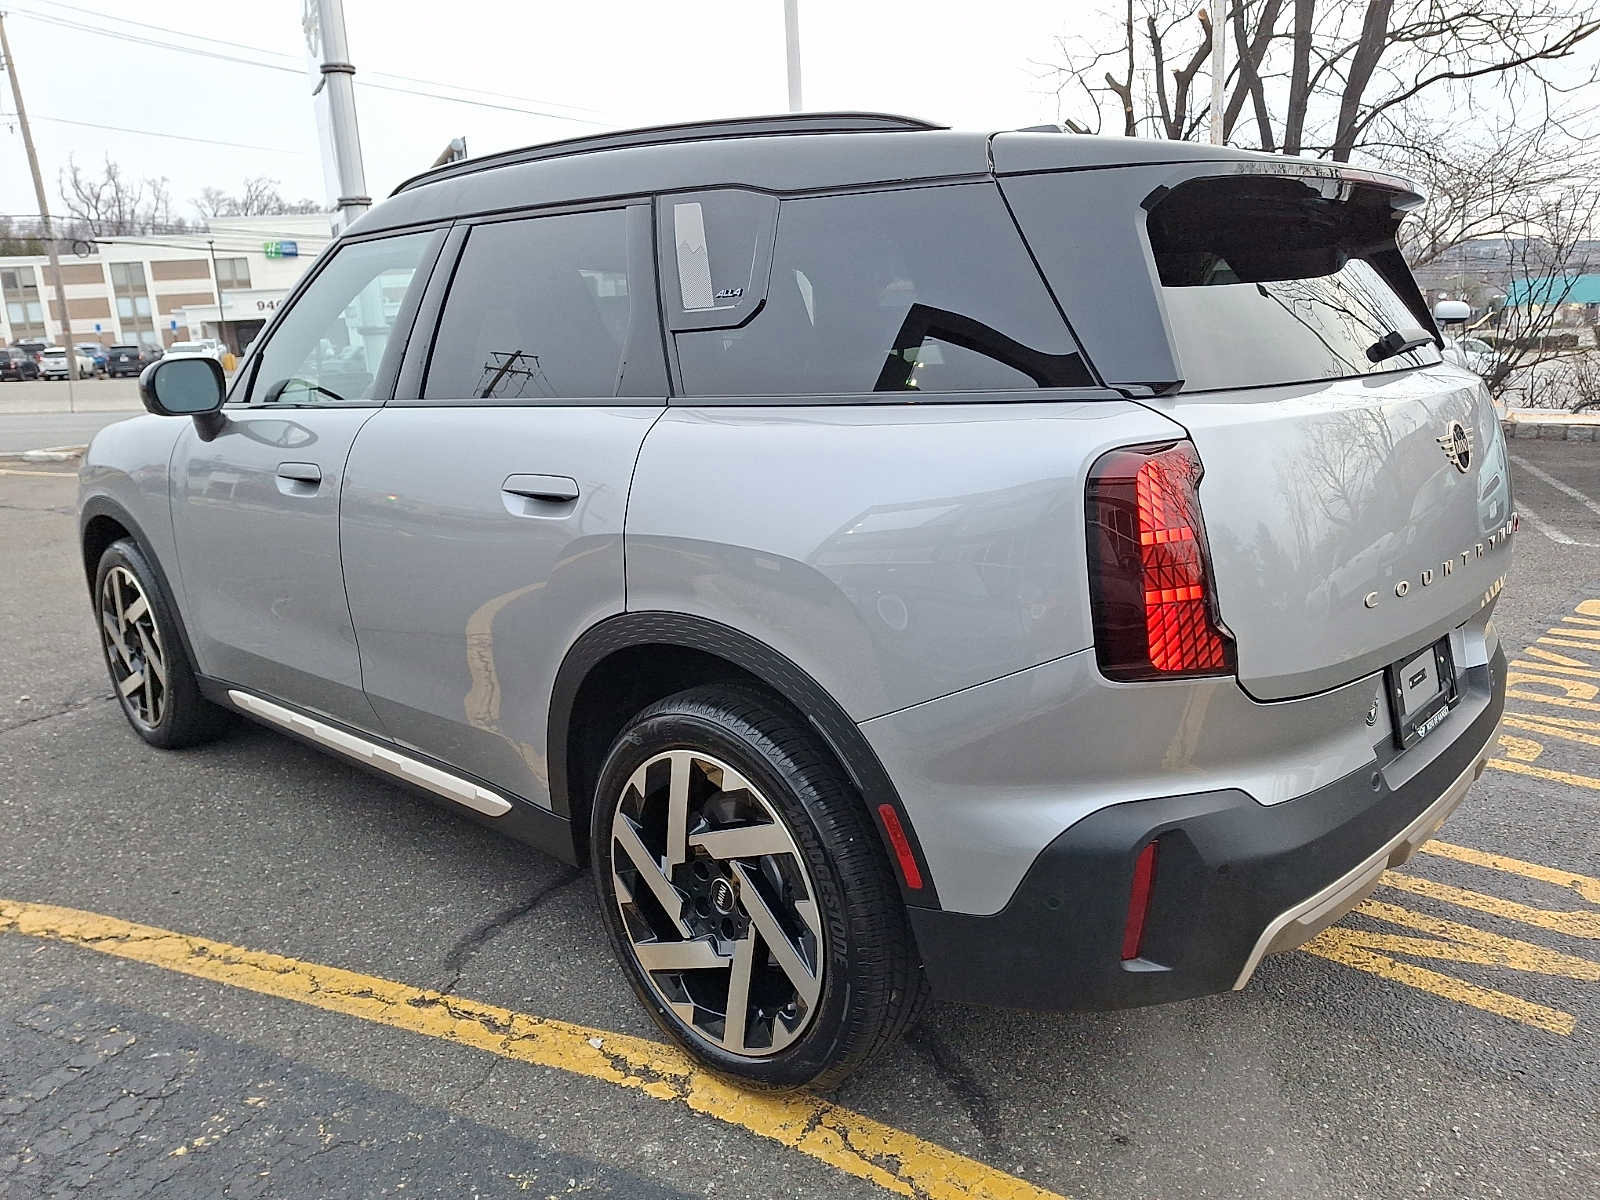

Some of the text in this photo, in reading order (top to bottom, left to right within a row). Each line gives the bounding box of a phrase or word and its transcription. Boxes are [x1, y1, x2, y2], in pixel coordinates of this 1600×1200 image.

[715, 287, 743, 299] ALL4
[256, 299, 281, 312] 94
[716, 883, 727, 907] MINI
